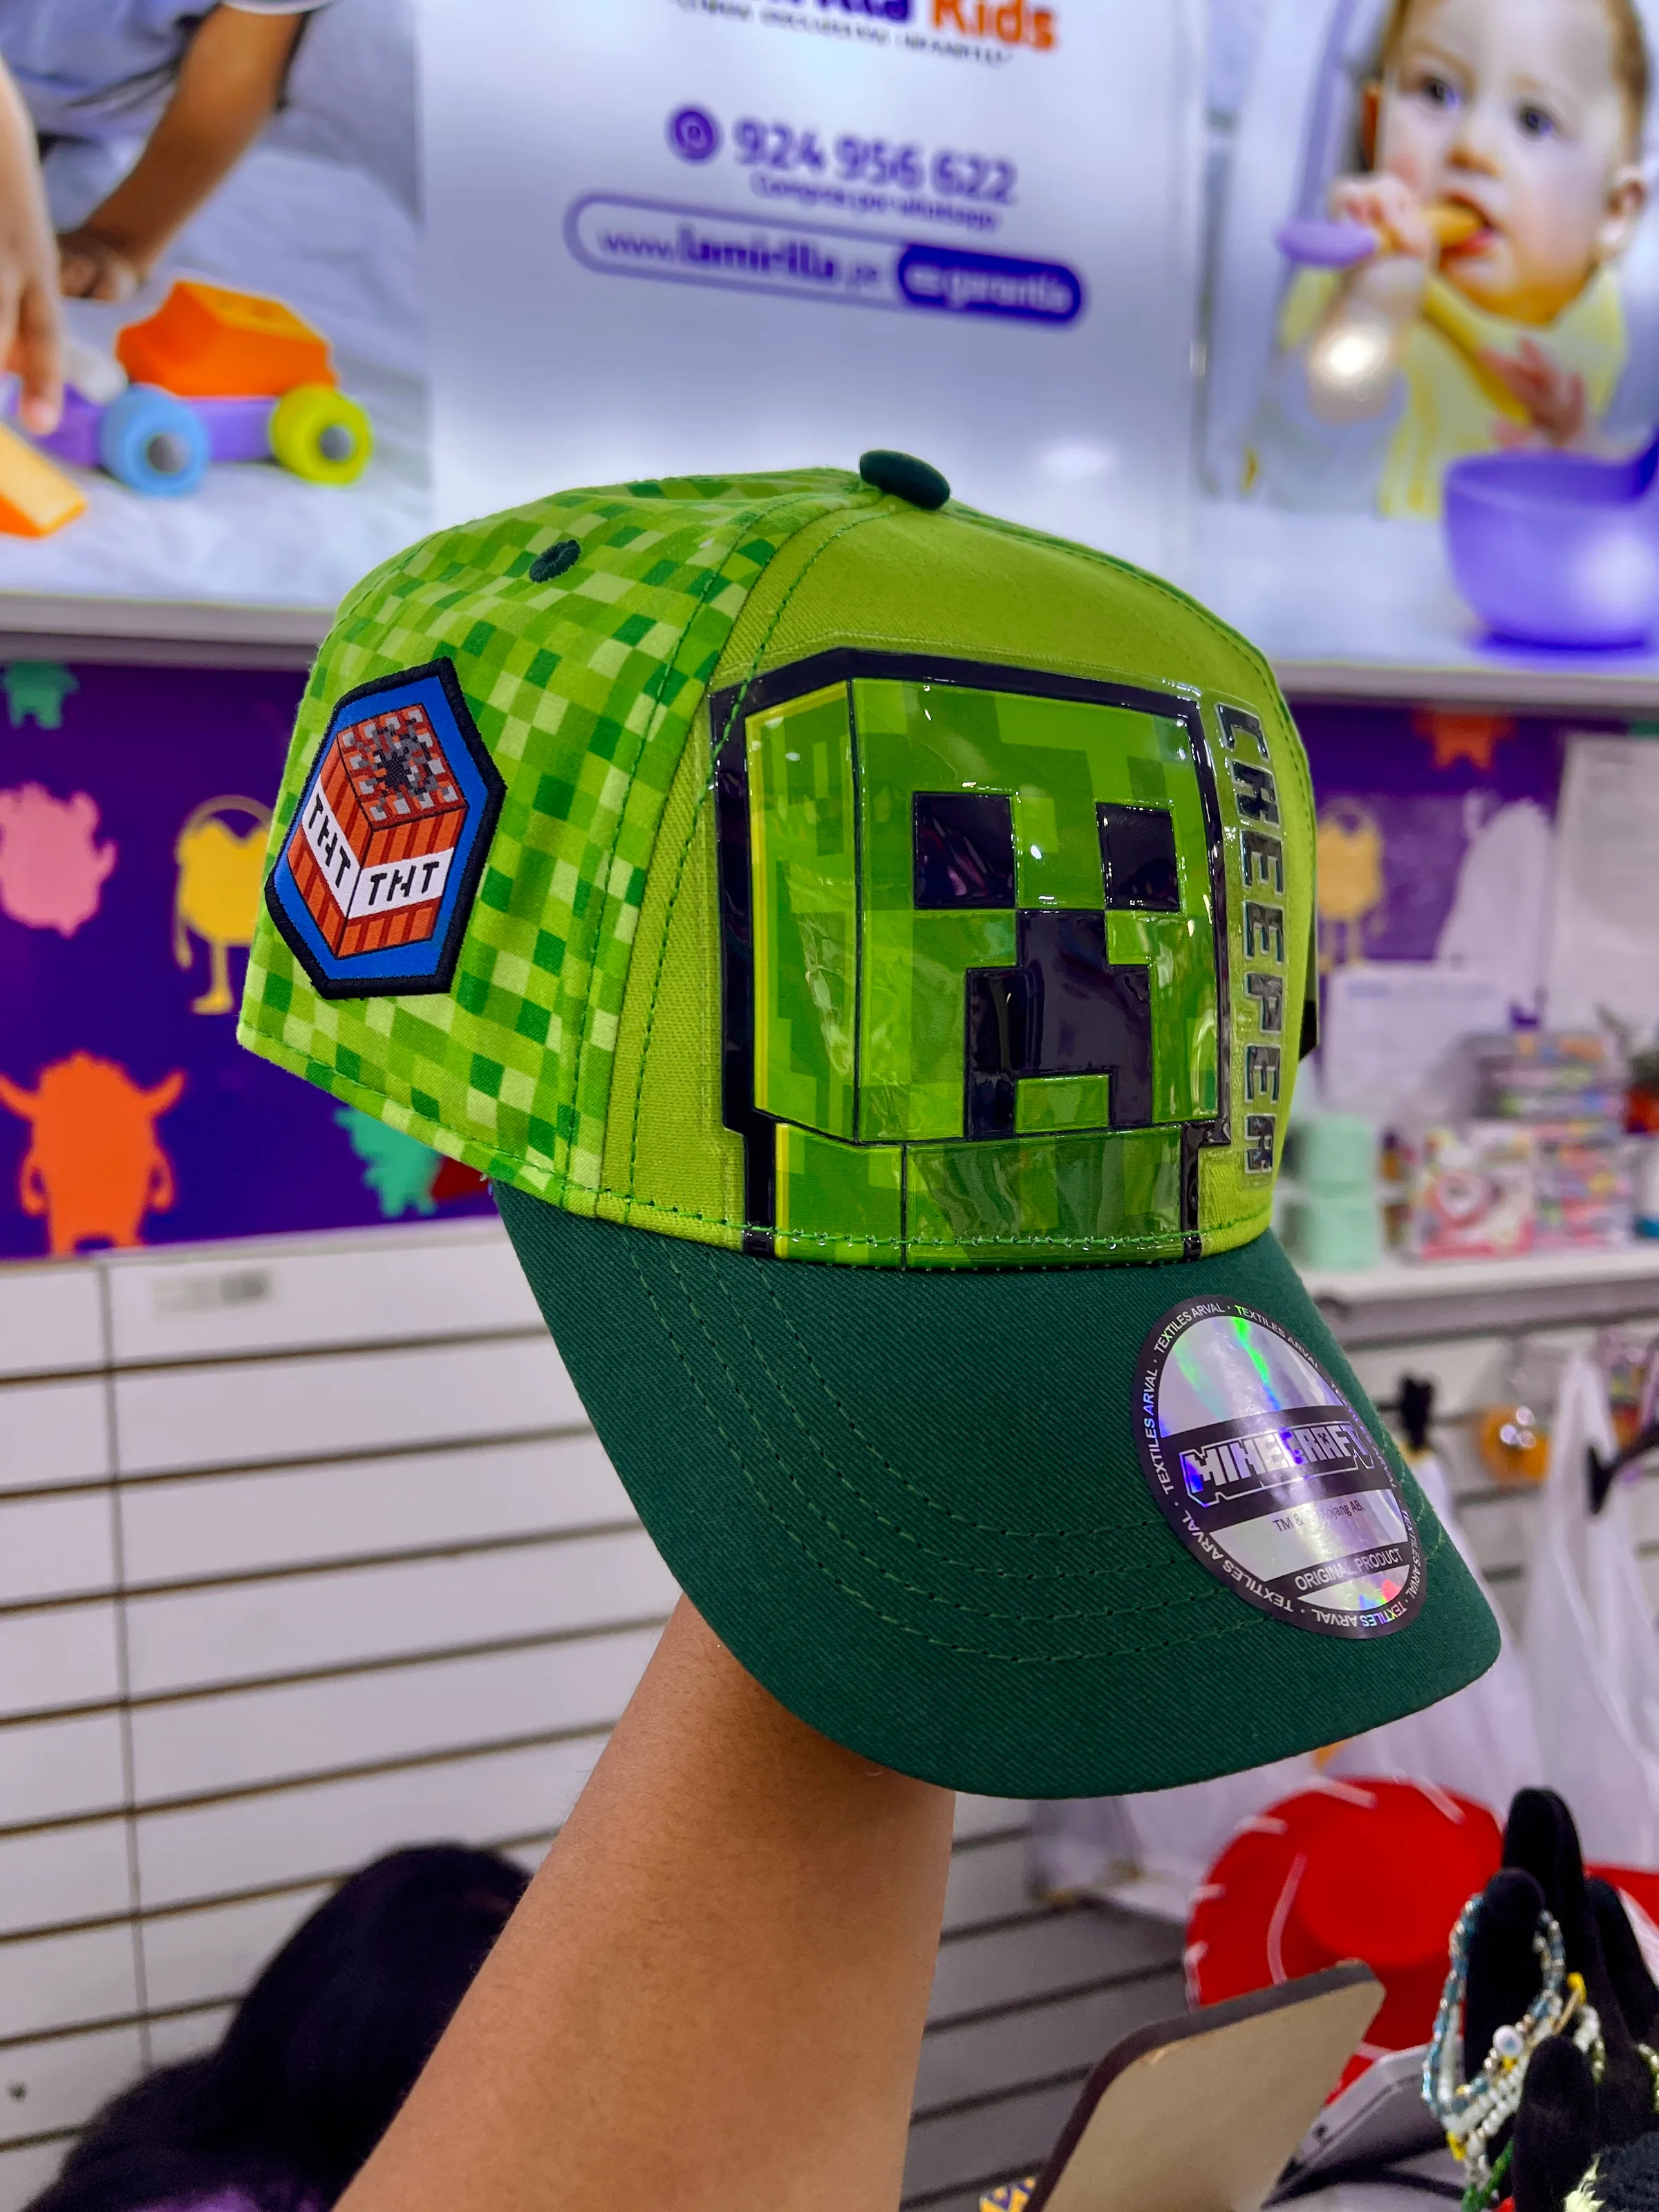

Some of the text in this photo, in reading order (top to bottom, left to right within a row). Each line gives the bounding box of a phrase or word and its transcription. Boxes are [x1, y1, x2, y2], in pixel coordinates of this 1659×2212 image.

[930, 0, 1058, 50] Kids
[733, 118, 1019, 205] 924 956 622
[308, 793, 352, 889] TNT
[368, 861, 440, 906] TNT
[1215, 702, 1286, 1175] CREEPER
[1153, 1302, 1226, 1354] TEXTILES ARVAL
[1234, 1304, 1321, 1373] TEXTILES ARVAL
[1143, 1368, 1174, 1496] TEXTILES ARVAL
[1183, 1423, 1369, 1494] MINECRAFT
[1273, 1516, 1295, 1533] TM
[1316, 1504, 1352, 1520] ojang
[1181, 1509, 1295, 1613] TEXTILES ARVAL
[1294, 1547, 1403, 1591] ORIGINAL PRODUCT
[1400, 1509, 1422, 1600] TEXTILES ARVAL
[1311, 1600, 1408, 1627] TEXTILES ARVAL
